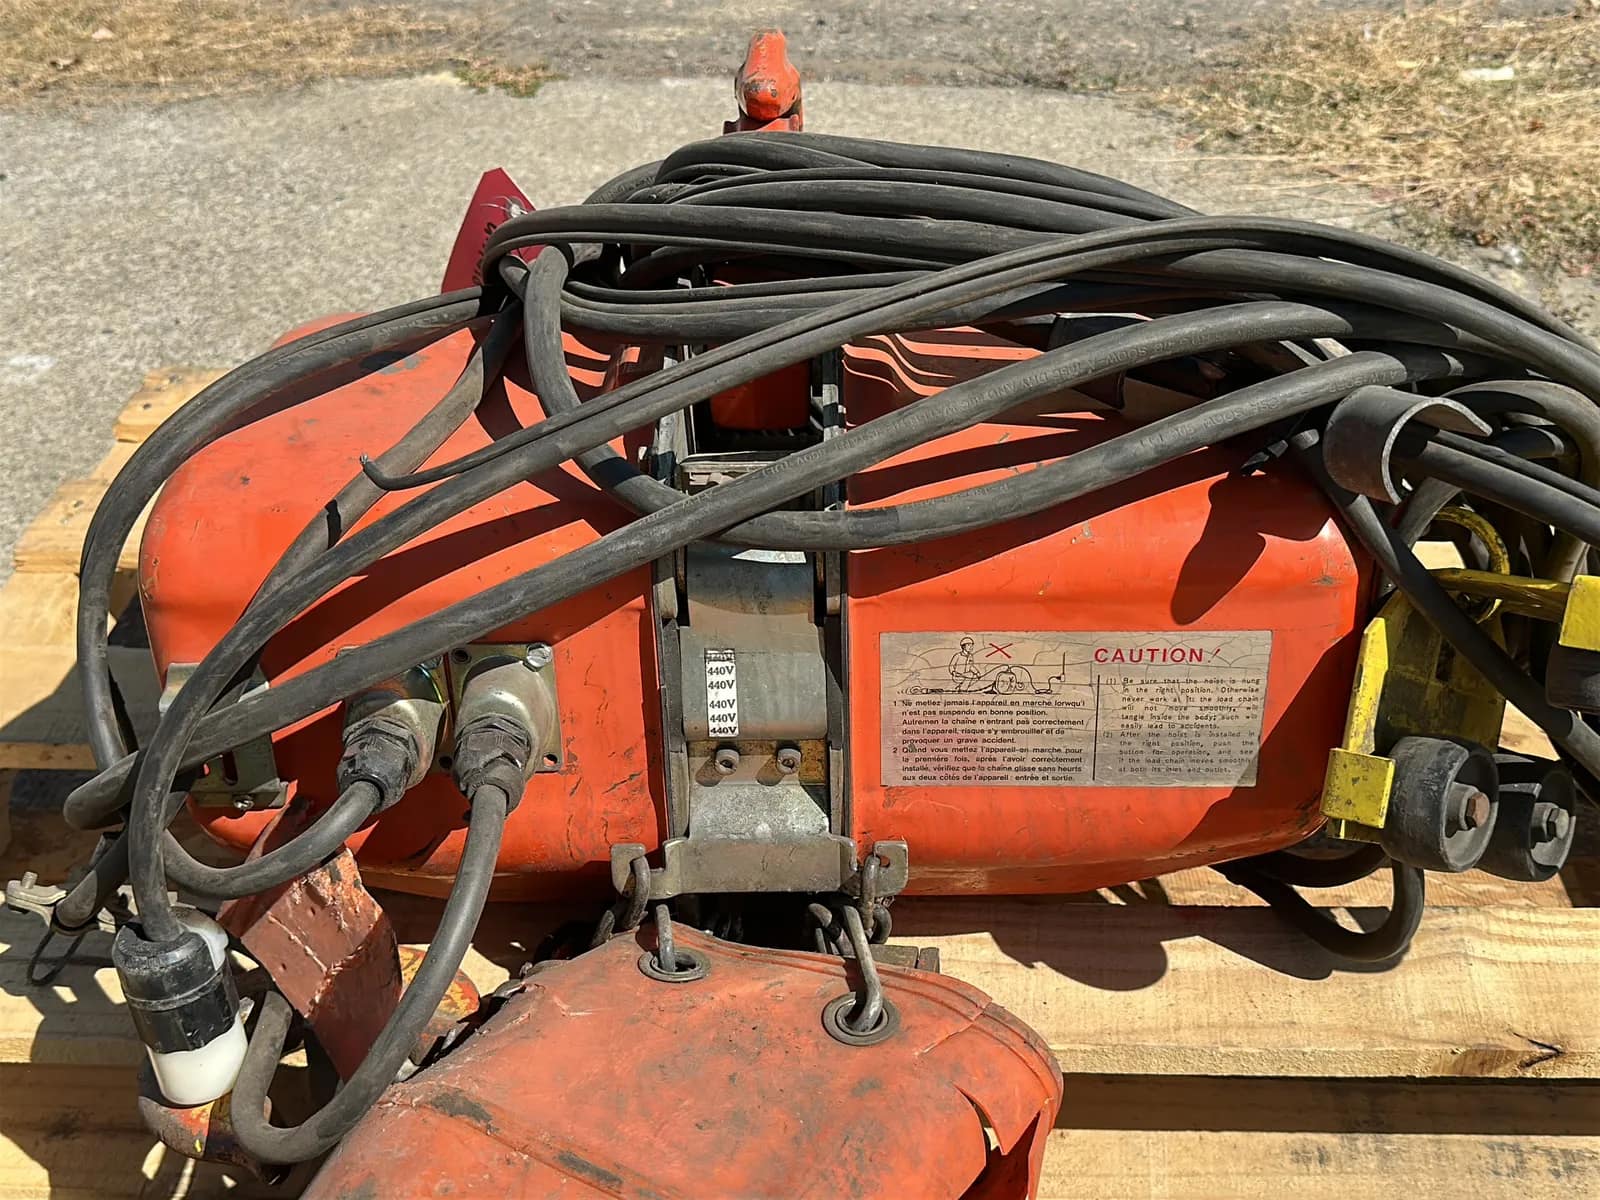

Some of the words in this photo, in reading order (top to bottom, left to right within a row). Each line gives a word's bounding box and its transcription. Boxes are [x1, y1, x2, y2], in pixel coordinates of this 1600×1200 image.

[708, 666, 734, 675] 440V
[708, 680, 735, 689] 440V
[709, 699, 735, 708] 440V
[710, 713, 736, 722] 440V
[939, 709, 976, 717] suspendu
[1016, 709, 1048, 717] position.
[961, 728, 985, 736] risque
[957, 737, 978, 745] grave
[981, 736, 1016, 744] accident.
